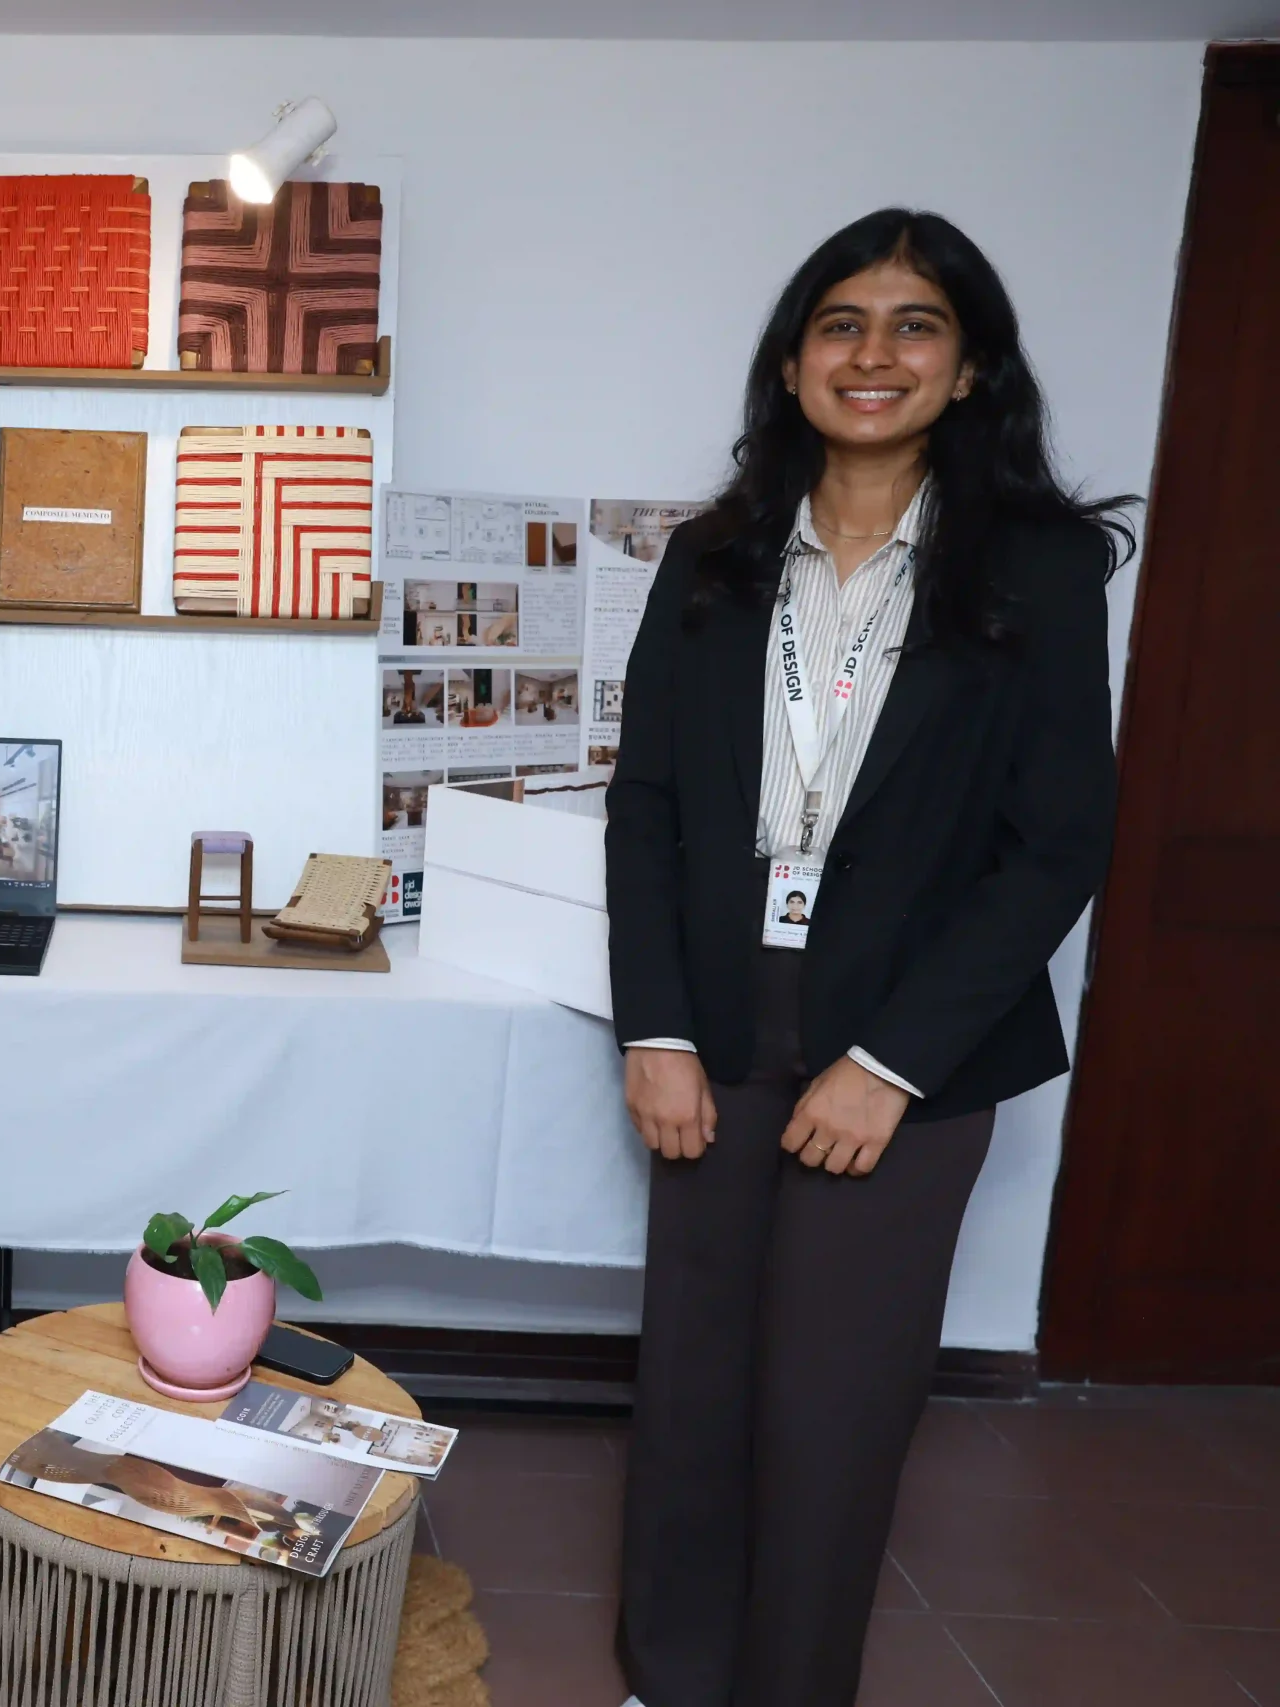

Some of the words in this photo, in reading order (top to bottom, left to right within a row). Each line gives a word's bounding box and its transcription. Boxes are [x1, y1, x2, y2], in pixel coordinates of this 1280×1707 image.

[25, 510, 68, 518] COMPOSITE
[632, 508, 657, 517] THE
[780, 614, 793, 636] OF
[843, 656, 857, 679] JD
[894, 563, 907, 587] OF
[782, 640, 803, 702] DESIGN
[84, 1394, 101, 1406] THE
[111, 1402, 130, 1419] COIR
[84, 1398, 115, 1425] CRAFTED
[236, 1407, 251, 1422] COIR
[105, 1407, 146, 1442] COLLECTIVE
[304, 1539, 324, 1563] CRAFT
